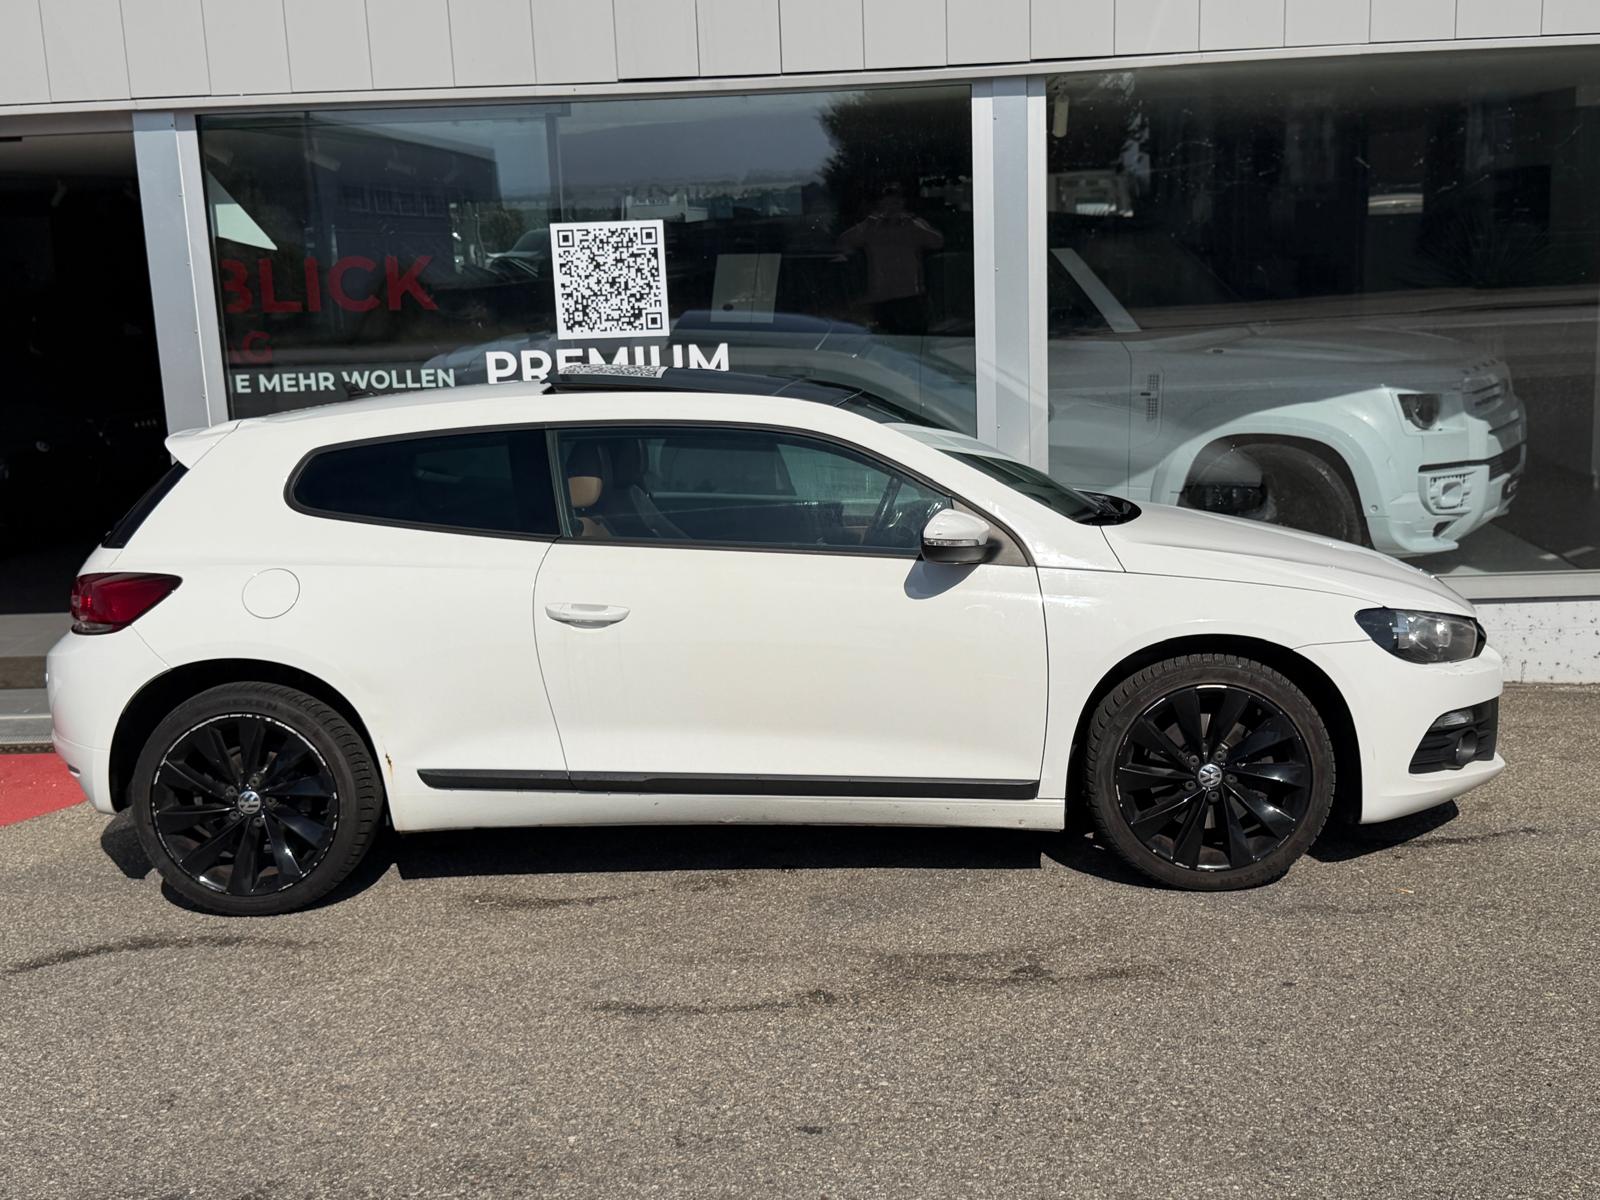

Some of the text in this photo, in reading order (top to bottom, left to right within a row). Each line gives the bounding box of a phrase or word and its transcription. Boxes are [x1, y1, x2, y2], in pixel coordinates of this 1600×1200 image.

[229, 331, 273, 364] G
[259, 372, 336, 393] MEHR
[341, 368, 455, 390] WOLLEN
